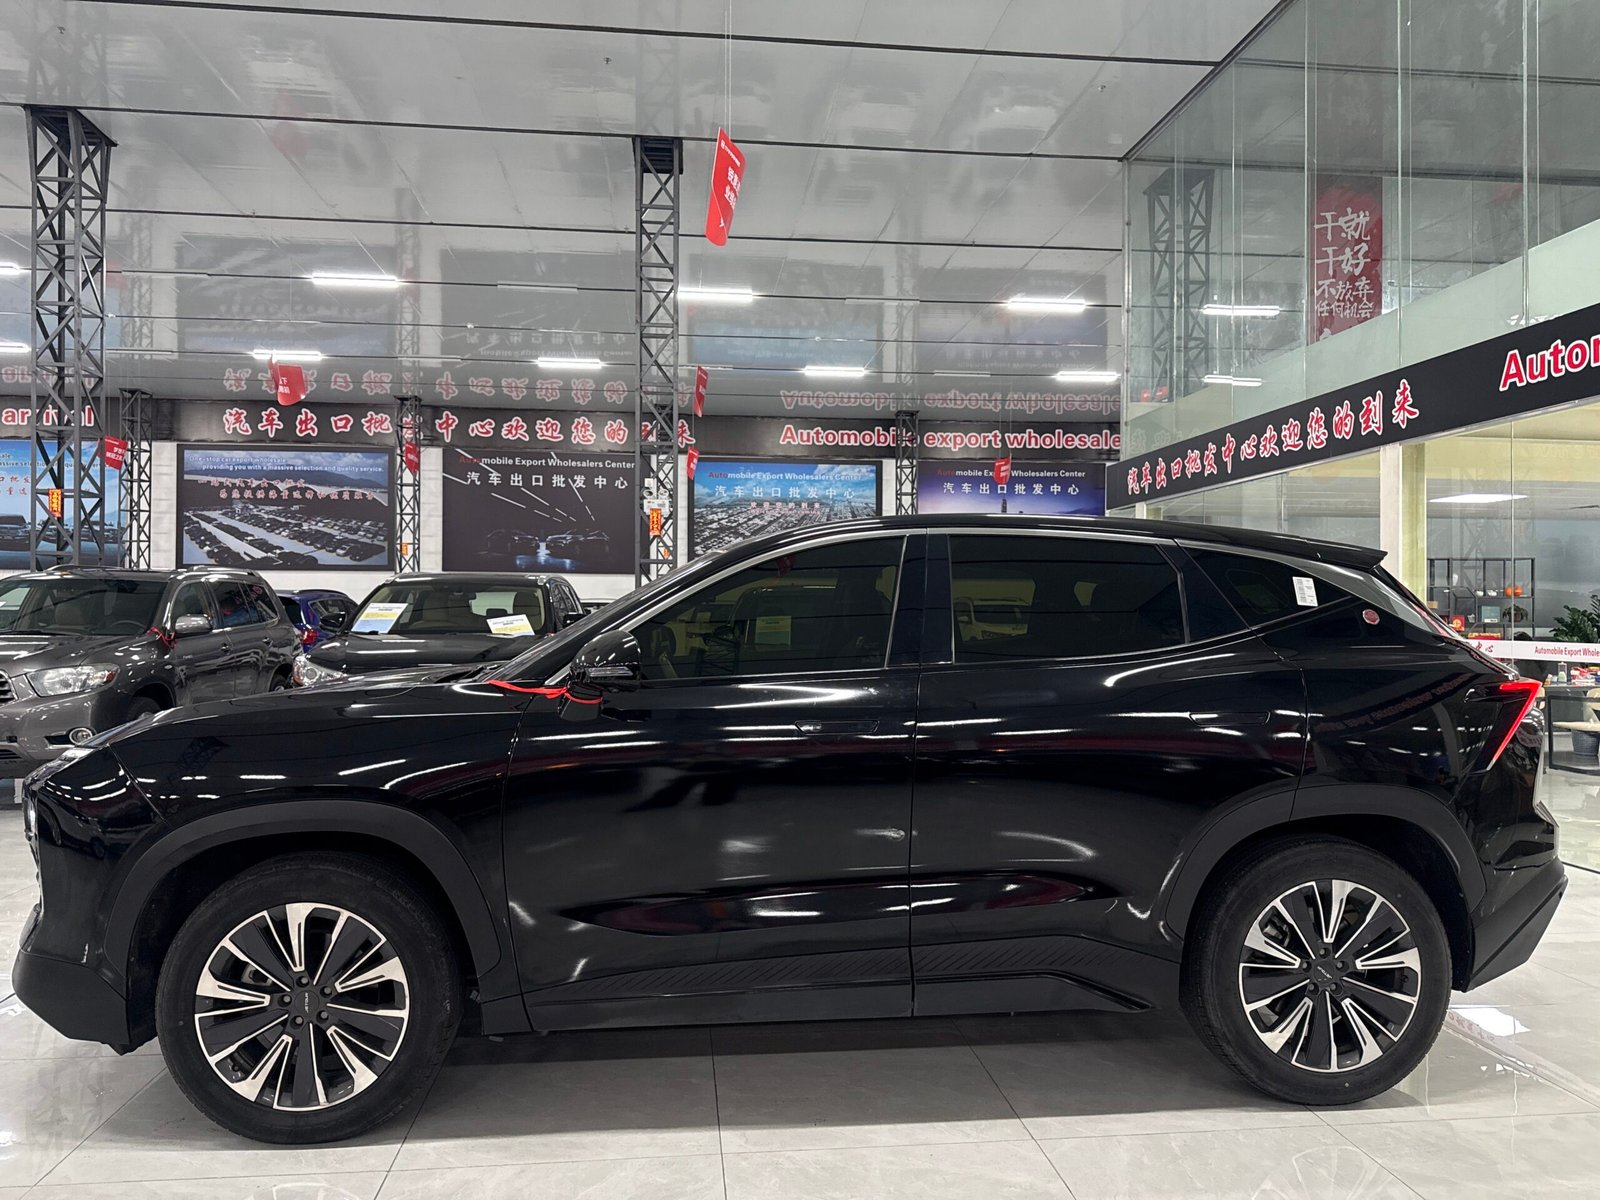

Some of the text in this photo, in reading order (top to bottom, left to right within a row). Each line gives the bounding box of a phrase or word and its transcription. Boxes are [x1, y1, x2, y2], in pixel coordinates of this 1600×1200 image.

[1315, 276, 1374, 301] 不放弃
[1315, 300, 1374, 318] 任何机会
[1499, 334, 1600, 391] Auto
[924, 430, 1001, 451] export
[1005, 428, 1121, 449] wholesale
[1127, 378, 1419, 495] 汽车出口批发中心欢迎您的到来
[515, 457, 546, 467] Export
[548, 459, 603, 468] Wholesalers
[605, 460, 635, 469] Center
[466, 471, 628, 489] 汽车出口批发中心
[708, 471, 754, 480] Automobile
[757, 472, 783, 481] Export
[785, 472, 834, 481] Wholesalers
[1060, 470, 1086, 478] Center
[715, 485, 855, 499] 汽车出口批发中心
[943, 482, 1080, 495] 汽车出口批发中心
[1535, 646, 1563, 656] Automobile
[1564, 647, 1582, 657] Export
